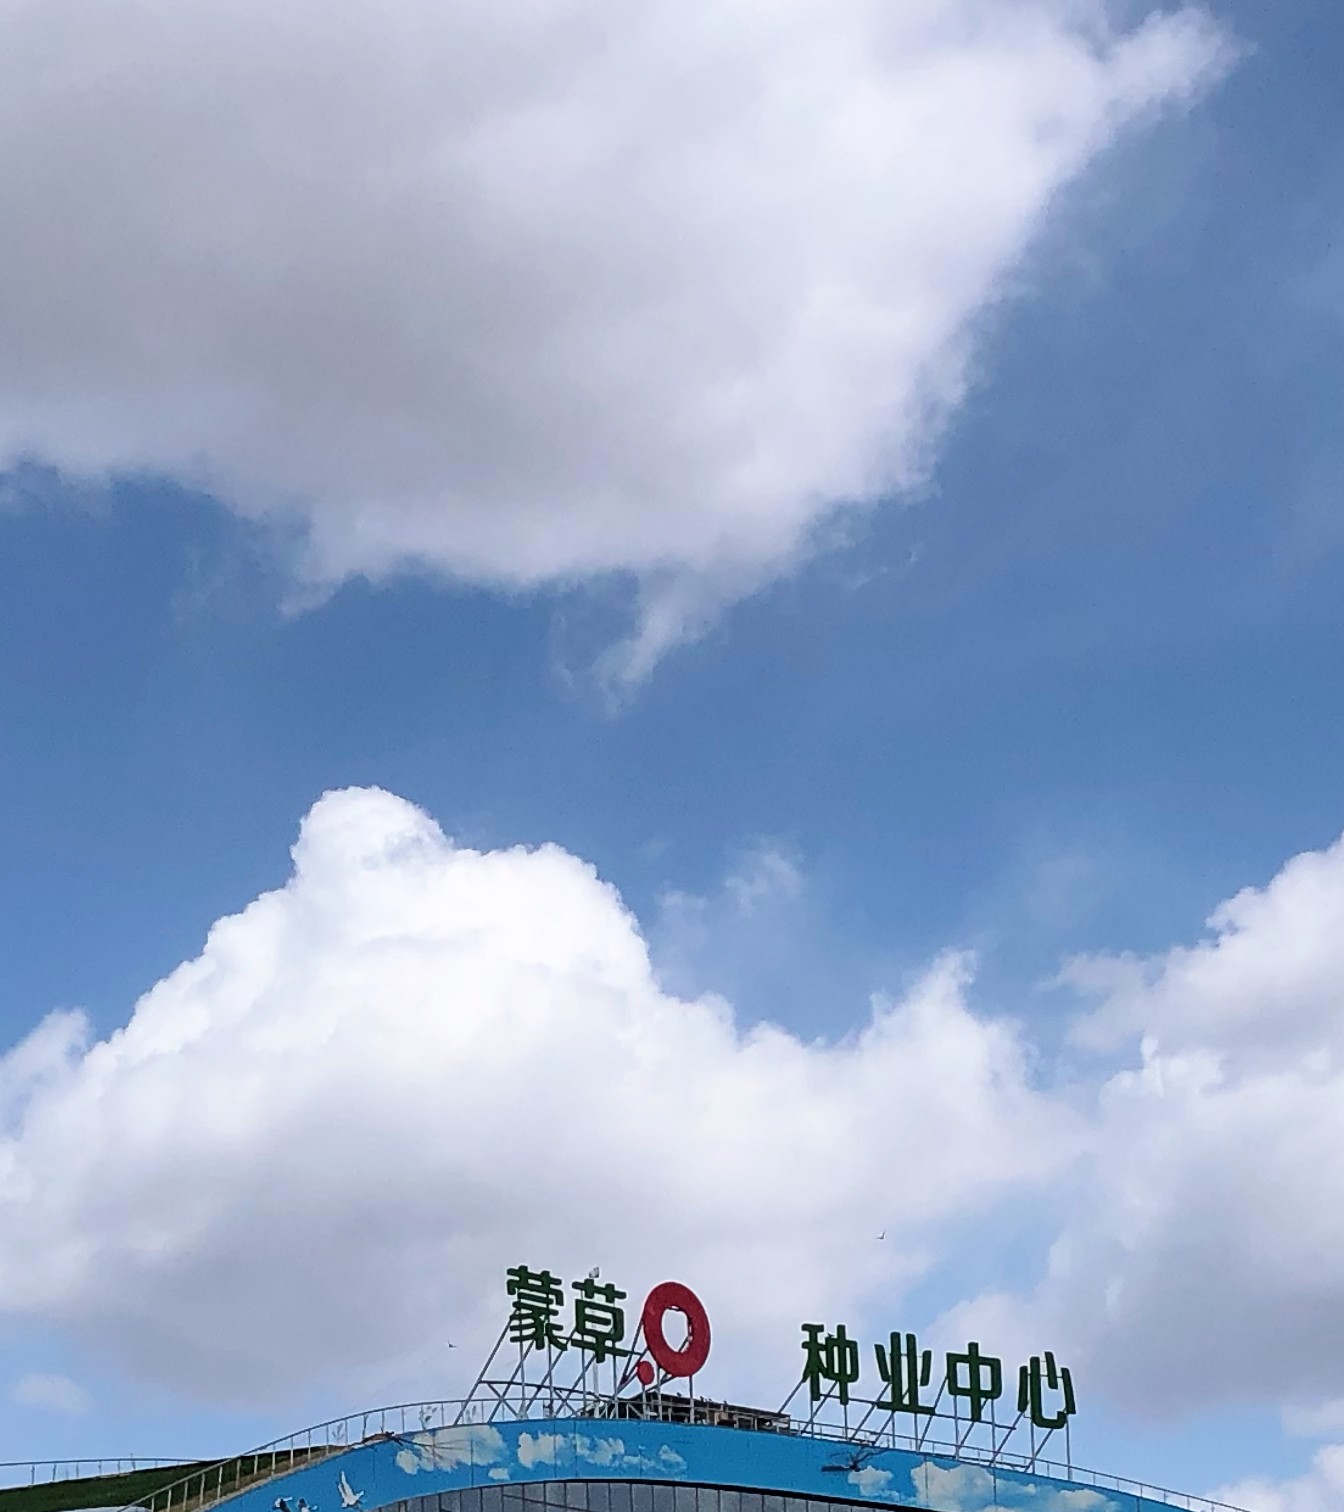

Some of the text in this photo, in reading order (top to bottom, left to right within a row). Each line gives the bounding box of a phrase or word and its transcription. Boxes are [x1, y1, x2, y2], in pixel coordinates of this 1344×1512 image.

[506, 1264, 630, 1362] 蒙草
[801, 1323, 1076, 1429] 种业中心
